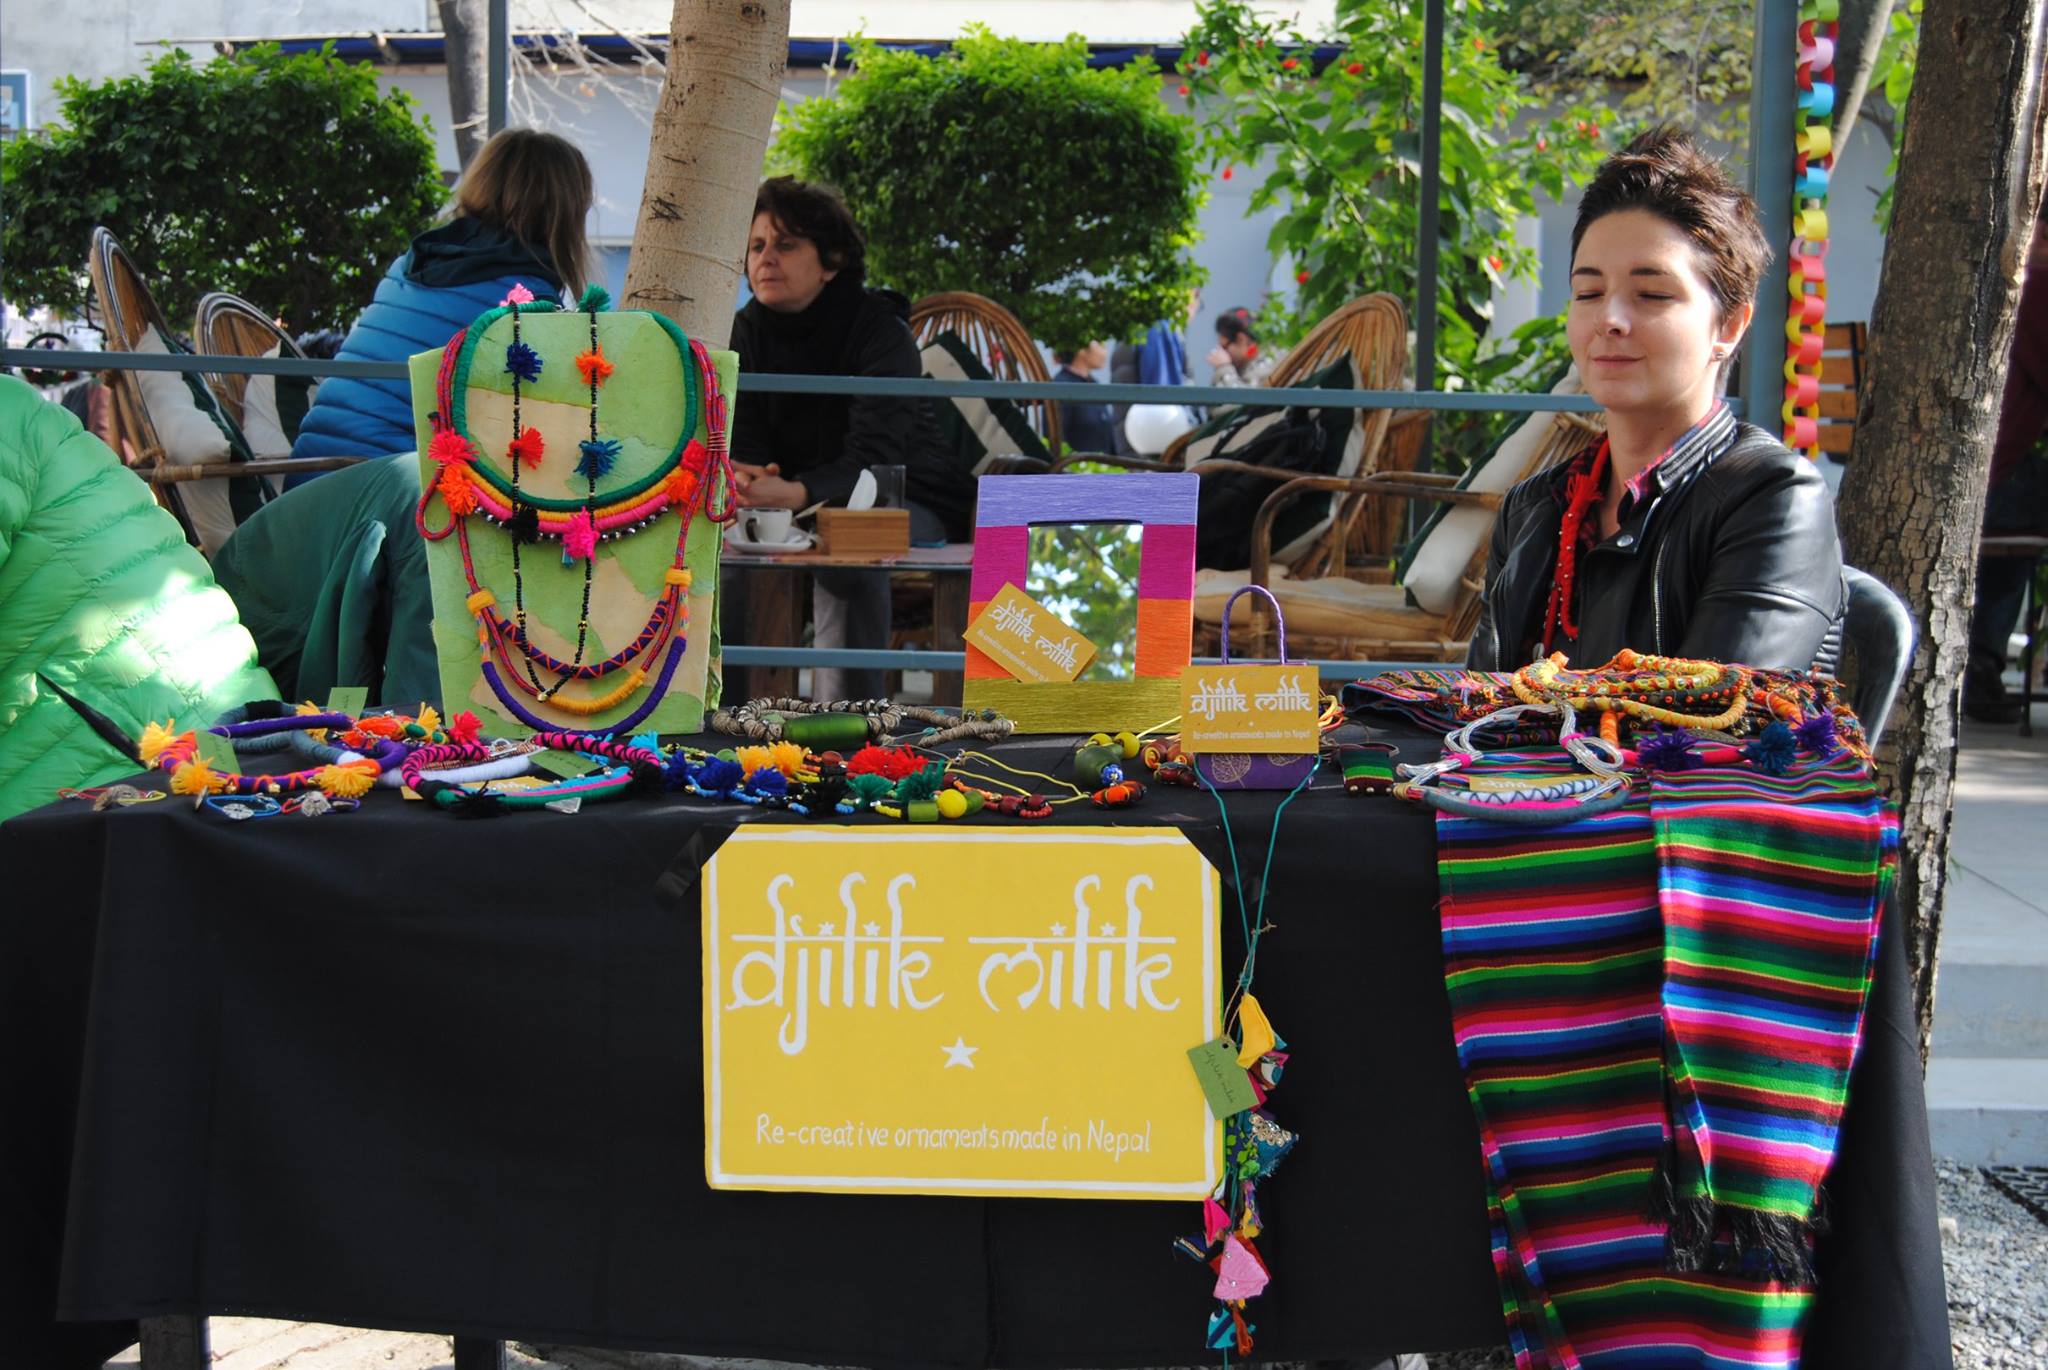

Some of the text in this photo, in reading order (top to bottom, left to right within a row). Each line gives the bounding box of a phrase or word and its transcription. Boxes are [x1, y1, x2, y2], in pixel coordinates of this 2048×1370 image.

[725, 872, 1181, 1056] djilik milik
[756, 1113, 889, 1147] Re-creative
[1062, 1128, 1081, 1152] in
[1087, 1120, 1152, 1163] Nepal
